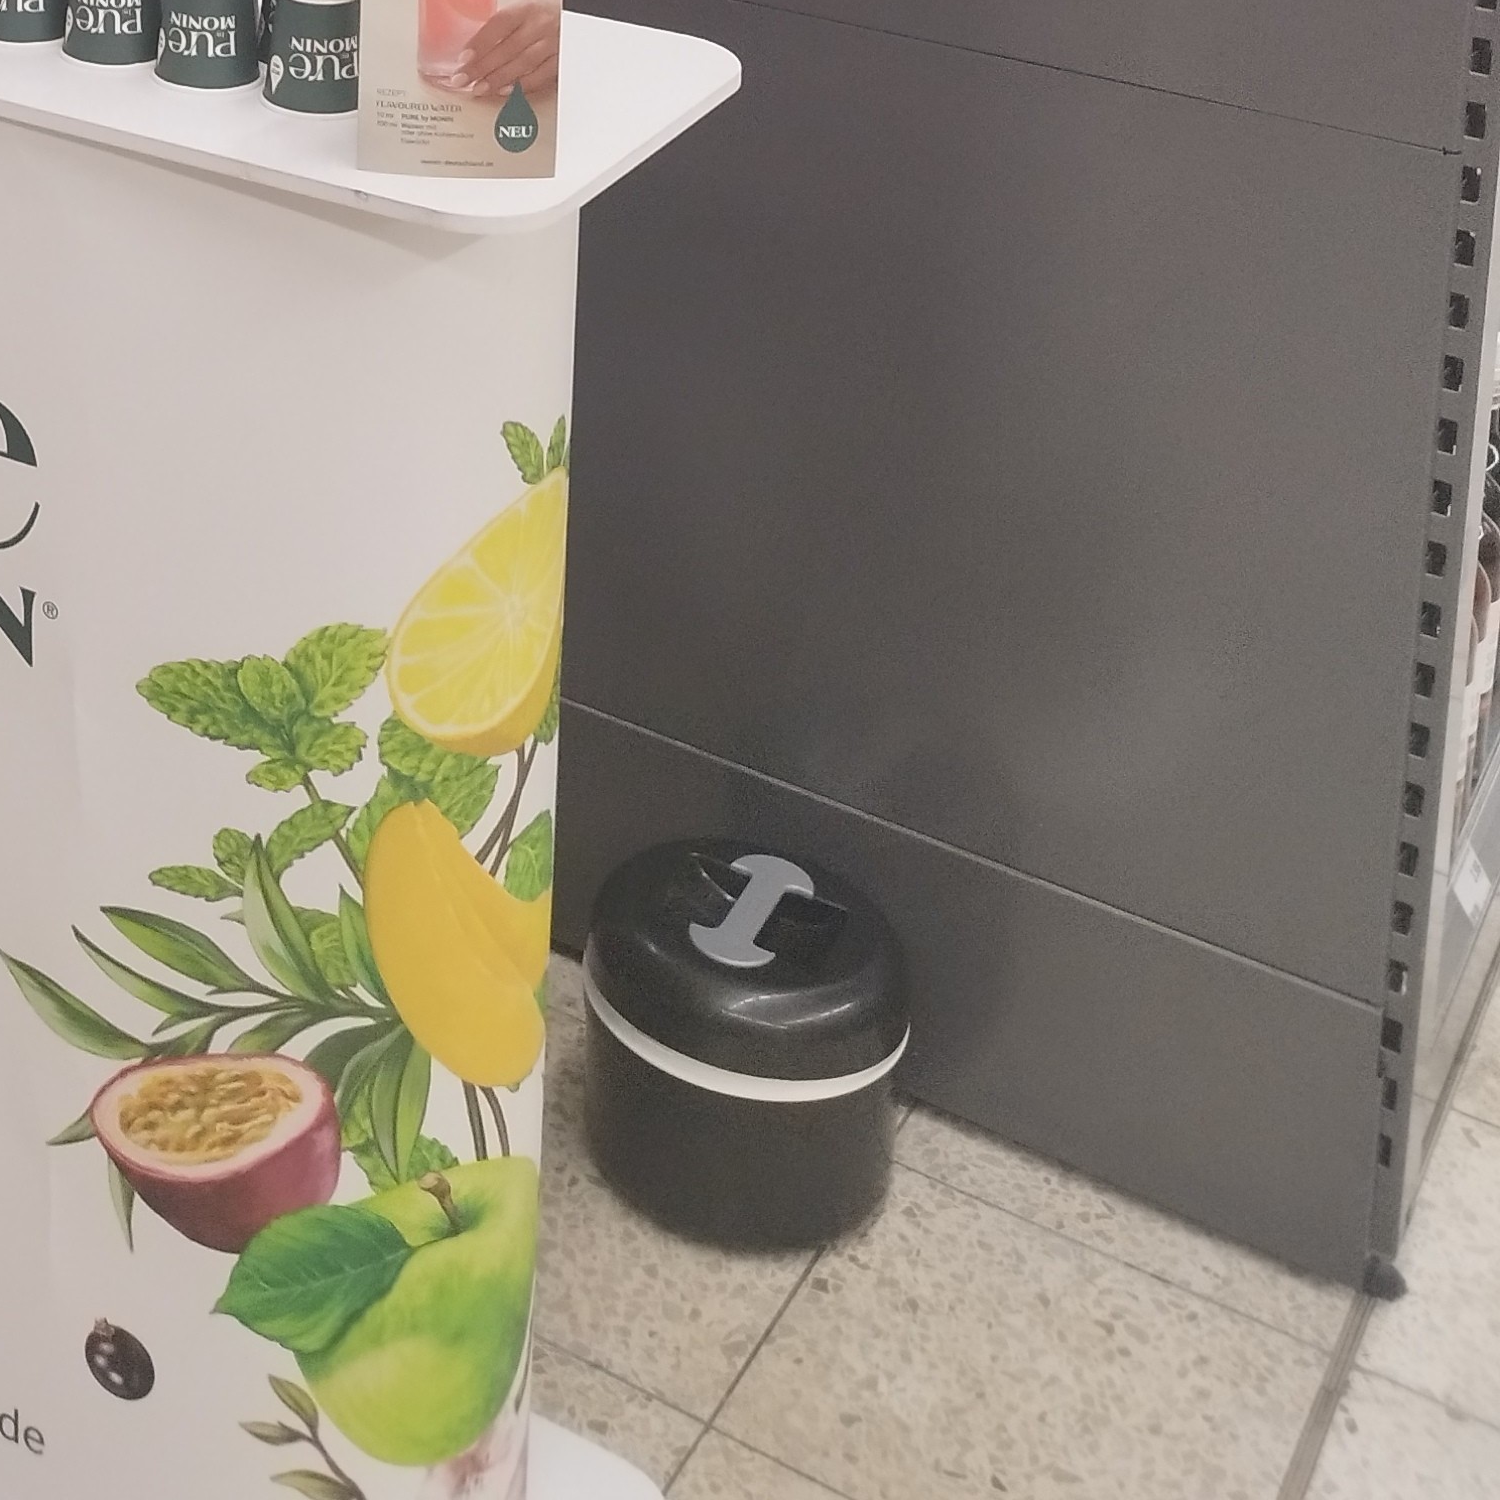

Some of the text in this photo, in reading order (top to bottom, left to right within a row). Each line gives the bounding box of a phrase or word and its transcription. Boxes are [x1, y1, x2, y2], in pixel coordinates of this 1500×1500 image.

[169, 10, 236, 31] MONIN
[290, 35, 358, 55] MONIN
[376, 100, 462, 113] FLAVOURED WATER
[499, 125, 534, 138] NEU
